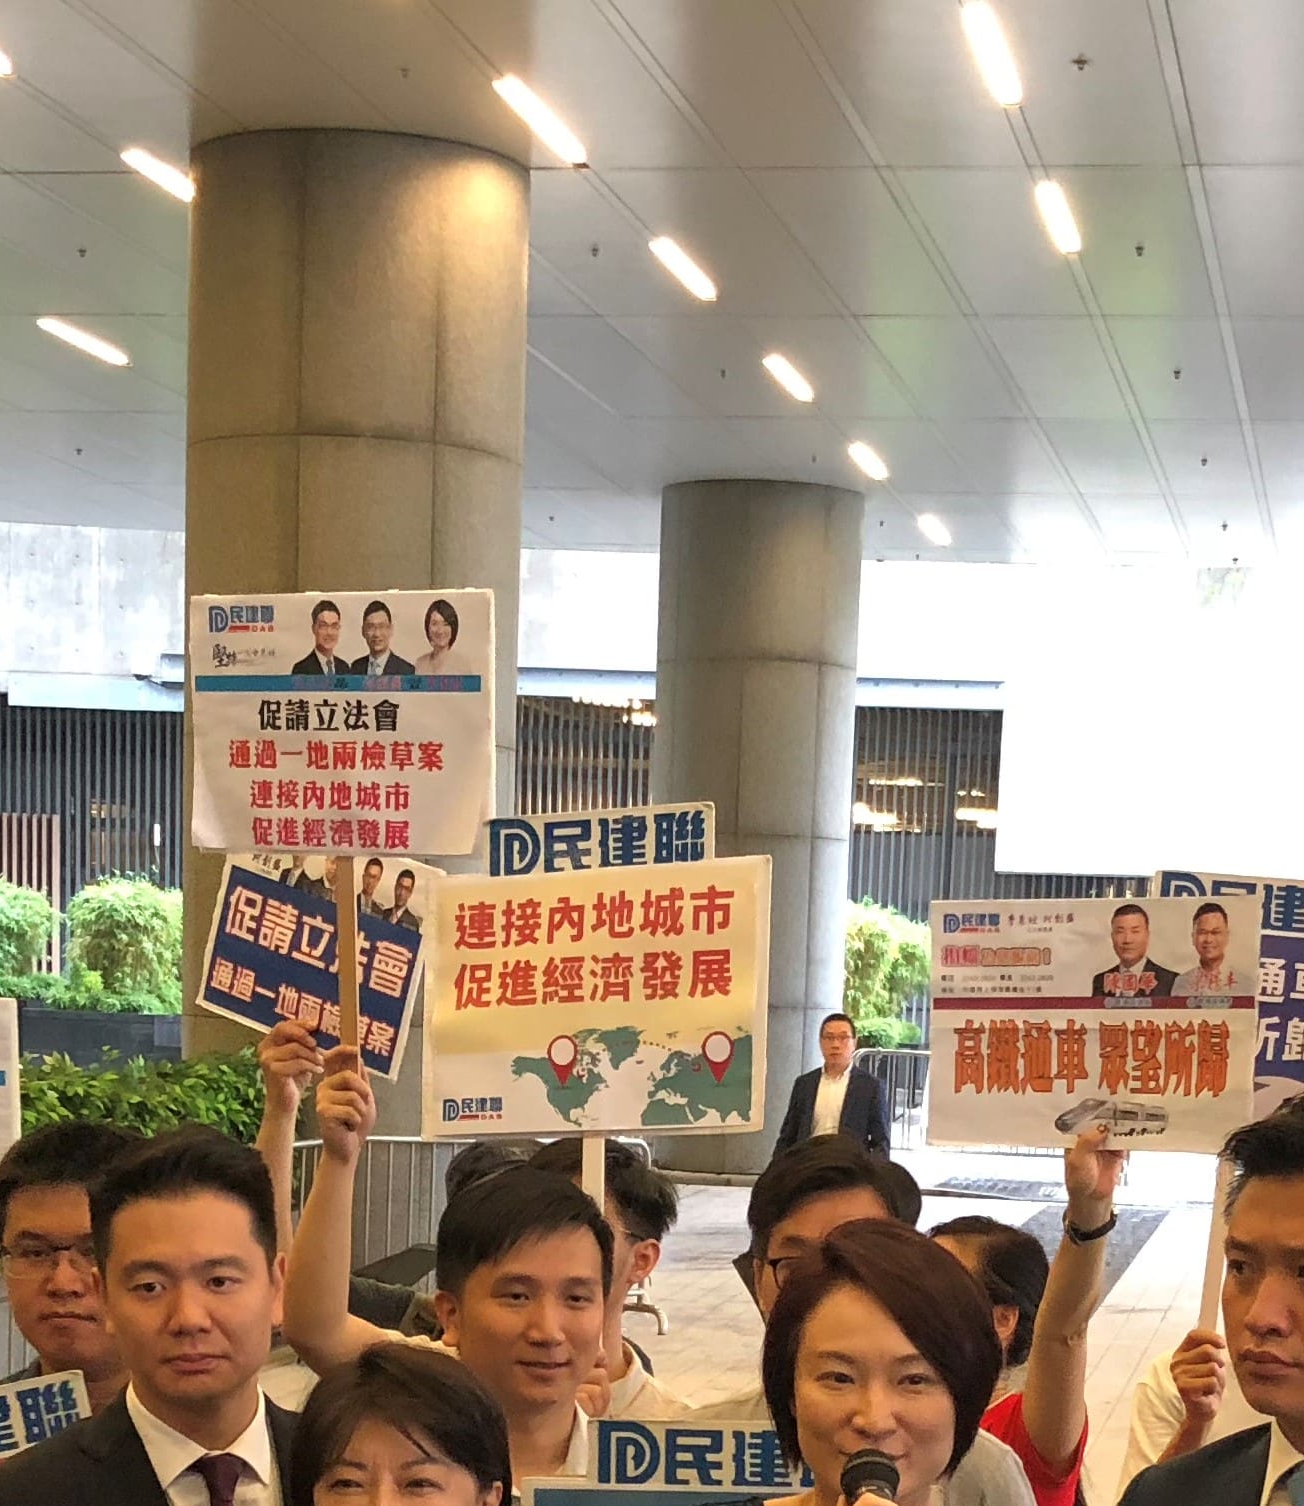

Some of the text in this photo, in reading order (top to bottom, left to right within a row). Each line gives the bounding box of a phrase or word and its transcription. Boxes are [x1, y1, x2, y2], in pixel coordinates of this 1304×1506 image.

[258, 699, 400, 732] 促請立法會
[229, 739, 444, 772] 通過一地兩檢草案
[250, 780, 410, 811] 連接內地城市
[252, 816, 410, 849] 促進經濟發展
[544, 810, 705, 874] 民建聯
[454, 885, 734, 950] 連接內地城市
[454, 949, 732, 1010] 促進經濟發展
[954, 1019, 1088, 1095] 高鐵通車
[461, 1097, 503, 1113] 民建聯
[665, 1429, 814, 1487] 民建
